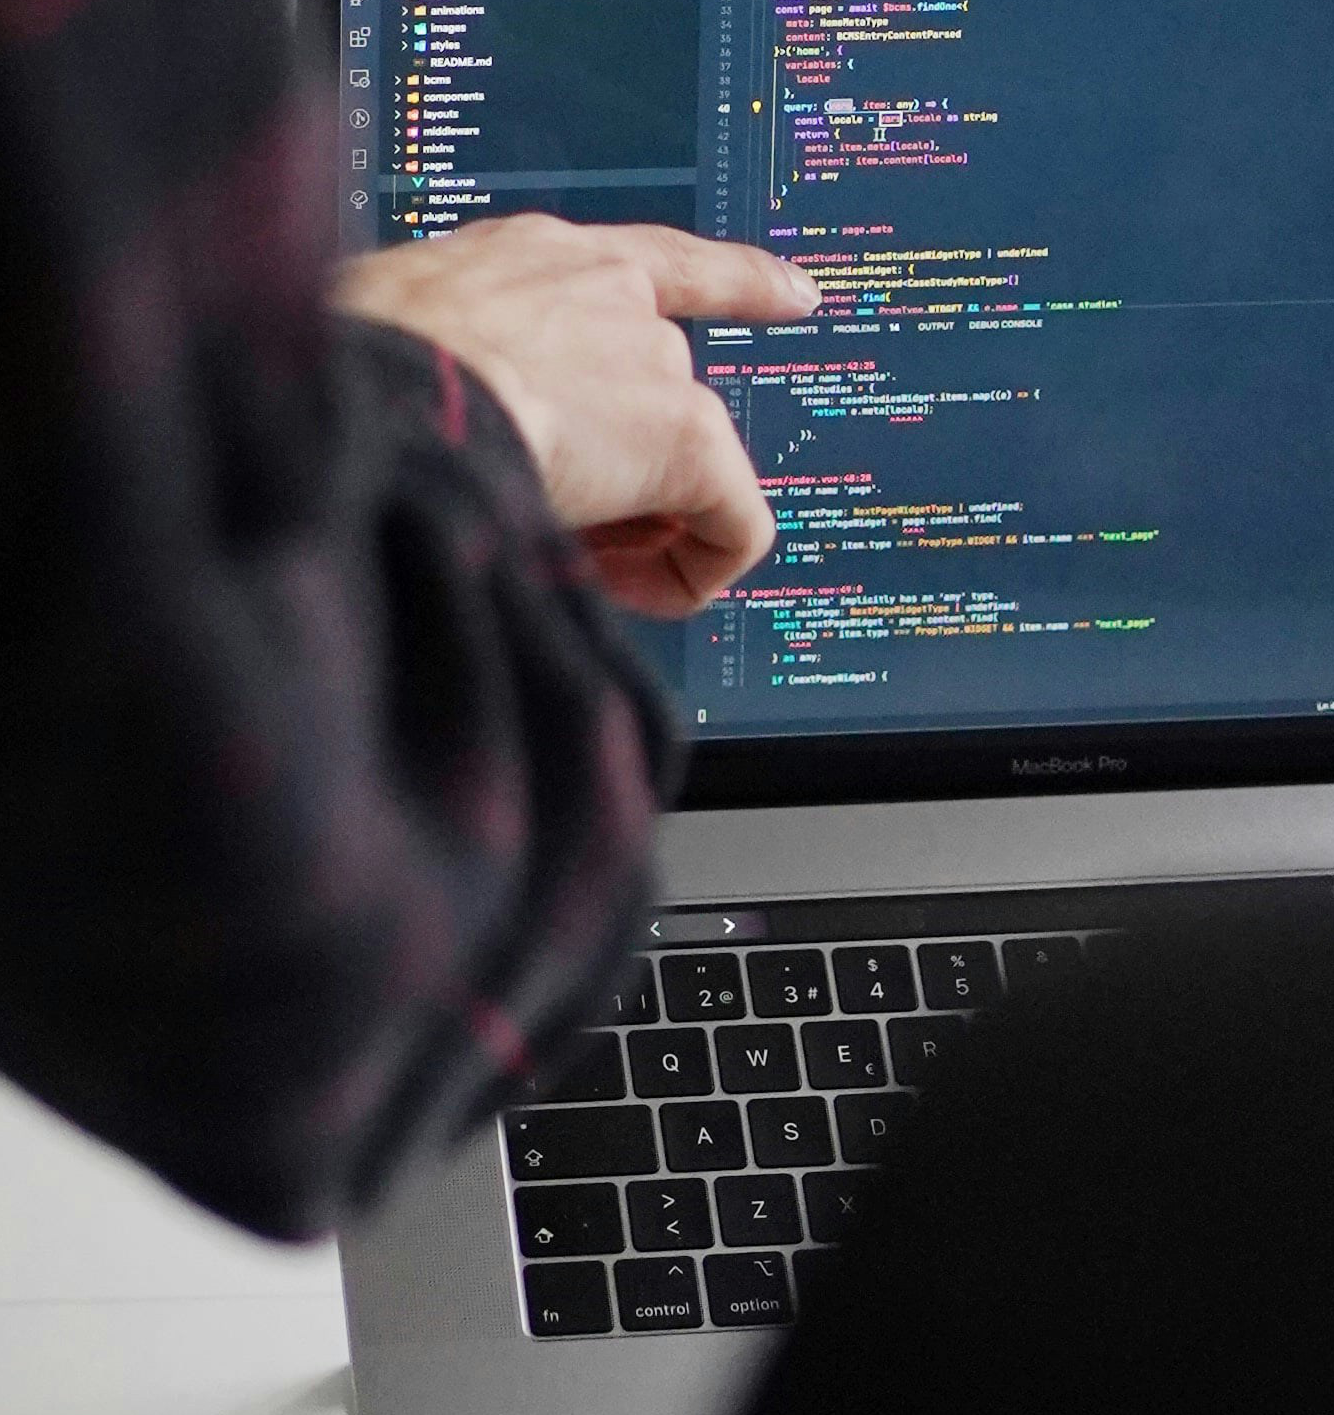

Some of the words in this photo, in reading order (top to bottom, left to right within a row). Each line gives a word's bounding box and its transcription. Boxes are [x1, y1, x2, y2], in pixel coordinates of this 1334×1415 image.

[430, 5, 485, 16] animations
[775, 5, 804, 15] const
[809, 5, 832, 16] page
[849, 2, 878, 14] await
[430, 23, 467, 35] images
[786, 19, 814, 29] meta:
[785, 32, 830, 43] content:
[430, 39, 460, 52] styles
[430, 56, 492, 68] README.md
[785, 59, 841, 71] variables:
[424, 74, 451, 86] bcms
[796, 73, 831, 85] locale
[423, 92, 485, 103] components
[784, 103, 817, 112] query:
[423, 109, 459, 121] layouts
[795, 115, 824, 126] const
[828, 113, 863, 125] locale
[947, 113, 959, 123] as
[963, 111, 998, 123] string
[422, 125, 480, 137] middleware
[794, 130, 829, 140] return
[423, 143, 455, 154] mixins
[805, 143, 833, 154] meta:
[422, 161, 453, 173] pages
[805, 157, 849, 168] content:
[428, 177, 476, 188] index.vue
[804, 172, 816, 181] as
[821, 171, 839, 182] any
[429, 193, 490, 205] README.md
[422, 211, 458, 224] plugins
[769, 226, 798, 237] const
[802, 226, 826, 236] hero
[842, 224, 894, 237] page.meta
[792, 253, 858, 263] caseStudies:
[997, 247, 1048, 259] undefined
[708, 327, 752, 338] TERMINAL
[767, 325, 818, 336] COMMENTS
[833, 323, 880, 334] PROBLEMS
[918, 321, 955, 332] OUTPUT
[969, 320, 999, 330] DEBUG
[1001, 318, 1043, 329] CONSOLE
[1098, 755, 1127, 771] Pro
[867, 958, 879, 972] $
[950, 954, 966, 968] %
[870, 981, 885, 999] 4
[955, 977, 970, 996] 5
[698, 989, 714, 1007] 2
[718, 990, 734, 1004] @
[784, 985, 799, 1004] 3
[807, 987, 818, 1000] #
[837, 1045, 852, 1063] E
[922, 1040, 937, 1057] R
[662, 1053, 679, 1073] Q
[745, 1049, 768, 1067] W
[783, 1122, 800, 1141] S
[869, 1118, 886, 1136] D
[697, 1126, 714, 1145] A
[751, 1200, 768, 1219] Z
[635, 1301, 690, 1318] control
[729, 1298, 779, 1315] option
[542, 1309, 560, 1322] fn
